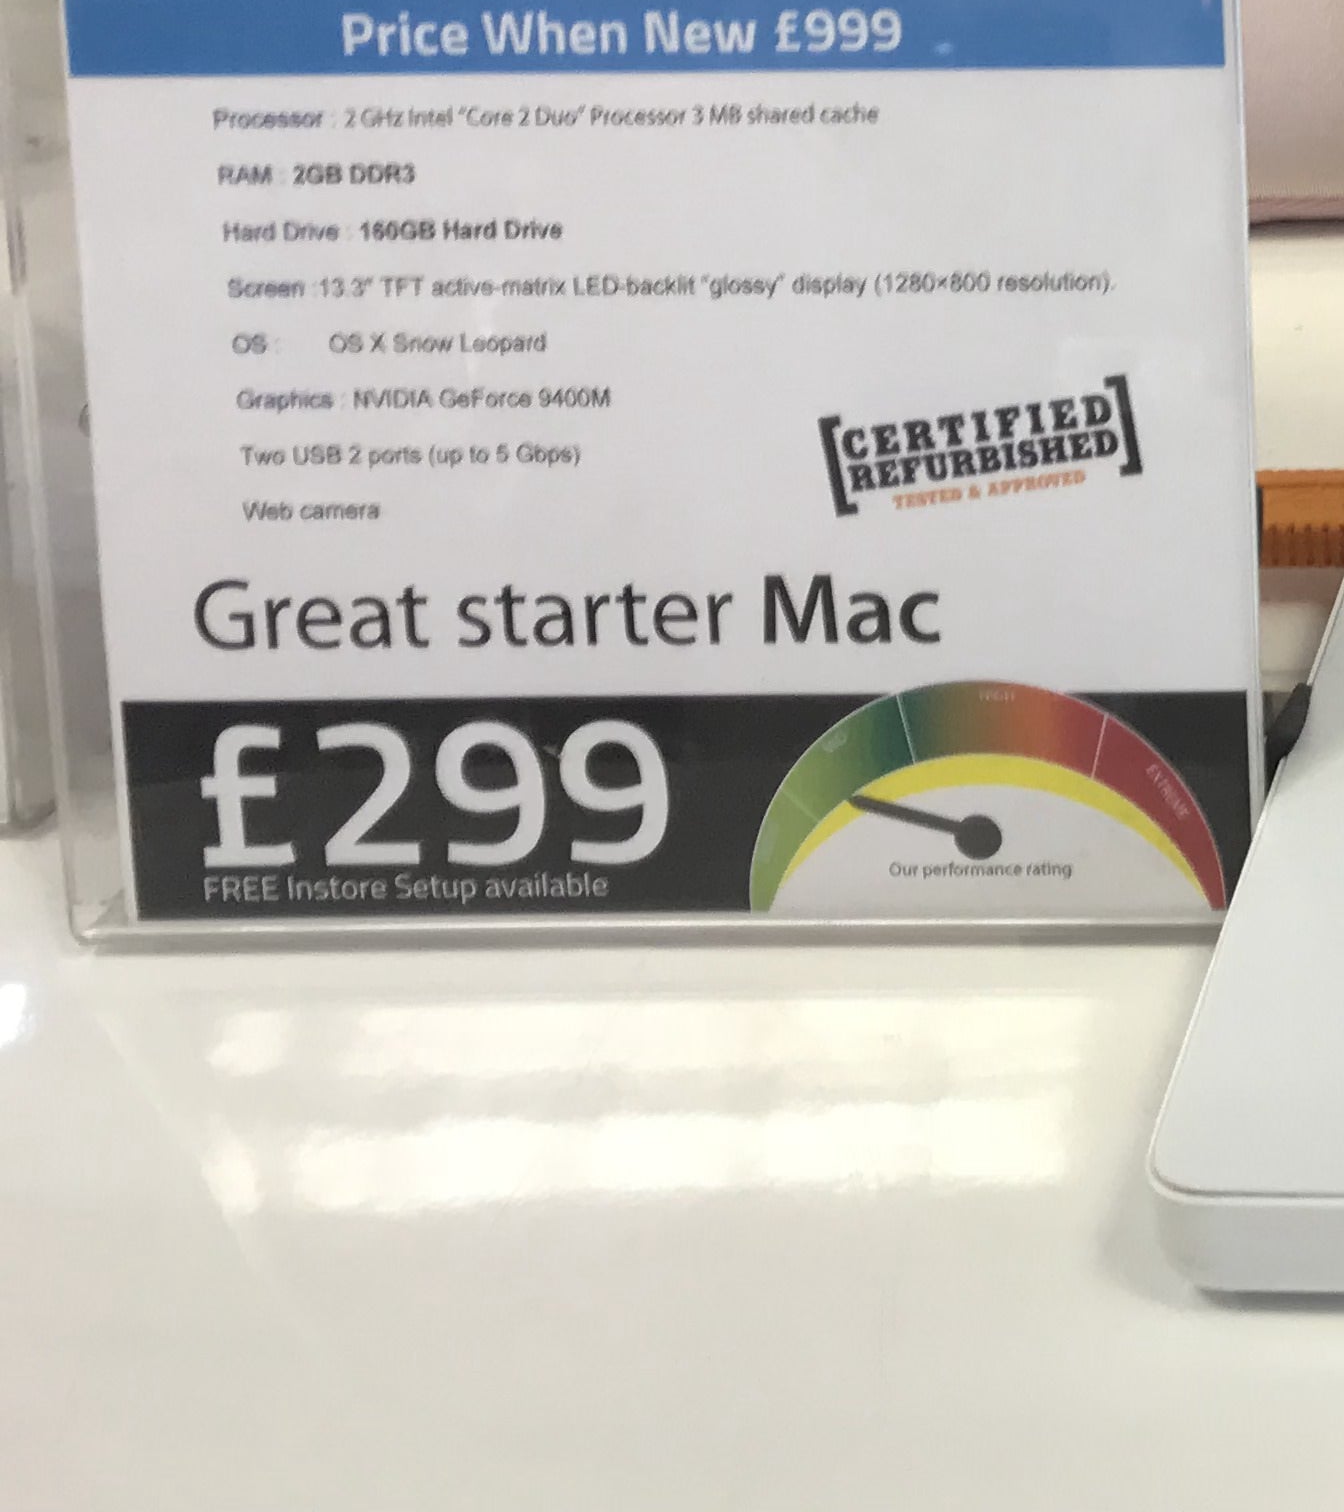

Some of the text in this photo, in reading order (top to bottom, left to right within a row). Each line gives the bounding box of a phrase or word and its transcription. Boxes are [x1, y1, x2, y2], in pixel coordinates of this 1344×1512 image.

[341, 7, 902, 57] Price When New £999
[213, 108, 323, 129] Processor
[345, 109, 356, 128] 2
[360, 108, 403, 127] GHz
[408, 106, 453, 127] Intel
[519, 108, 529, 126] 2
[590, 105, 686, 126] Processor
[692, 105, 704, 125] 3
[710, 105, 742, 124] MB
[747, 103, 815, 125] shared
[820, 102, 879, 124] cache
[218, 164, 415, 185] RAM 2GB DDR3
[223, 222, 277, 242] Hard
[283, 221, 340, 241] Drive
[443, 220, 497, 240] Hard
[504, 219, 563, 240] Drive
[228, 278, 305, 298] Screen
[380, 275, 424, 297] TFT
[432, 277, 566, 297] active-matrix
[573, 274, 695, 296] LED-backlit
[792, 274, 867, 298] display
[232, 332, 547, 356] OS OS X Snow Leopard
[236, 387, 611, 414] Graphics NVIDIA GeForce 9400M
[841, 393, 1113, 461] CERTIFIED
[240, 445, 286, 465] Two
[293, 444, 342, 465] USB
[349, 445, 361, 464] 2
[368, 447, 423, 469] ports
[429, 445, 464, 468] (up
[469, 446, 490, 464] to
[516, 443, 580, 467] Gbps)
[847, 429, 1119, 492] REFURBISHED
[243, 501, 380, 521] Web camera
[194, 574, 941, 651] Great starter Mac
[201, 719, 670, 868] £299
[889, 862, 1072, 879] Our performance rating
[203, 871, 609, 905] FREE Instore Setup available
